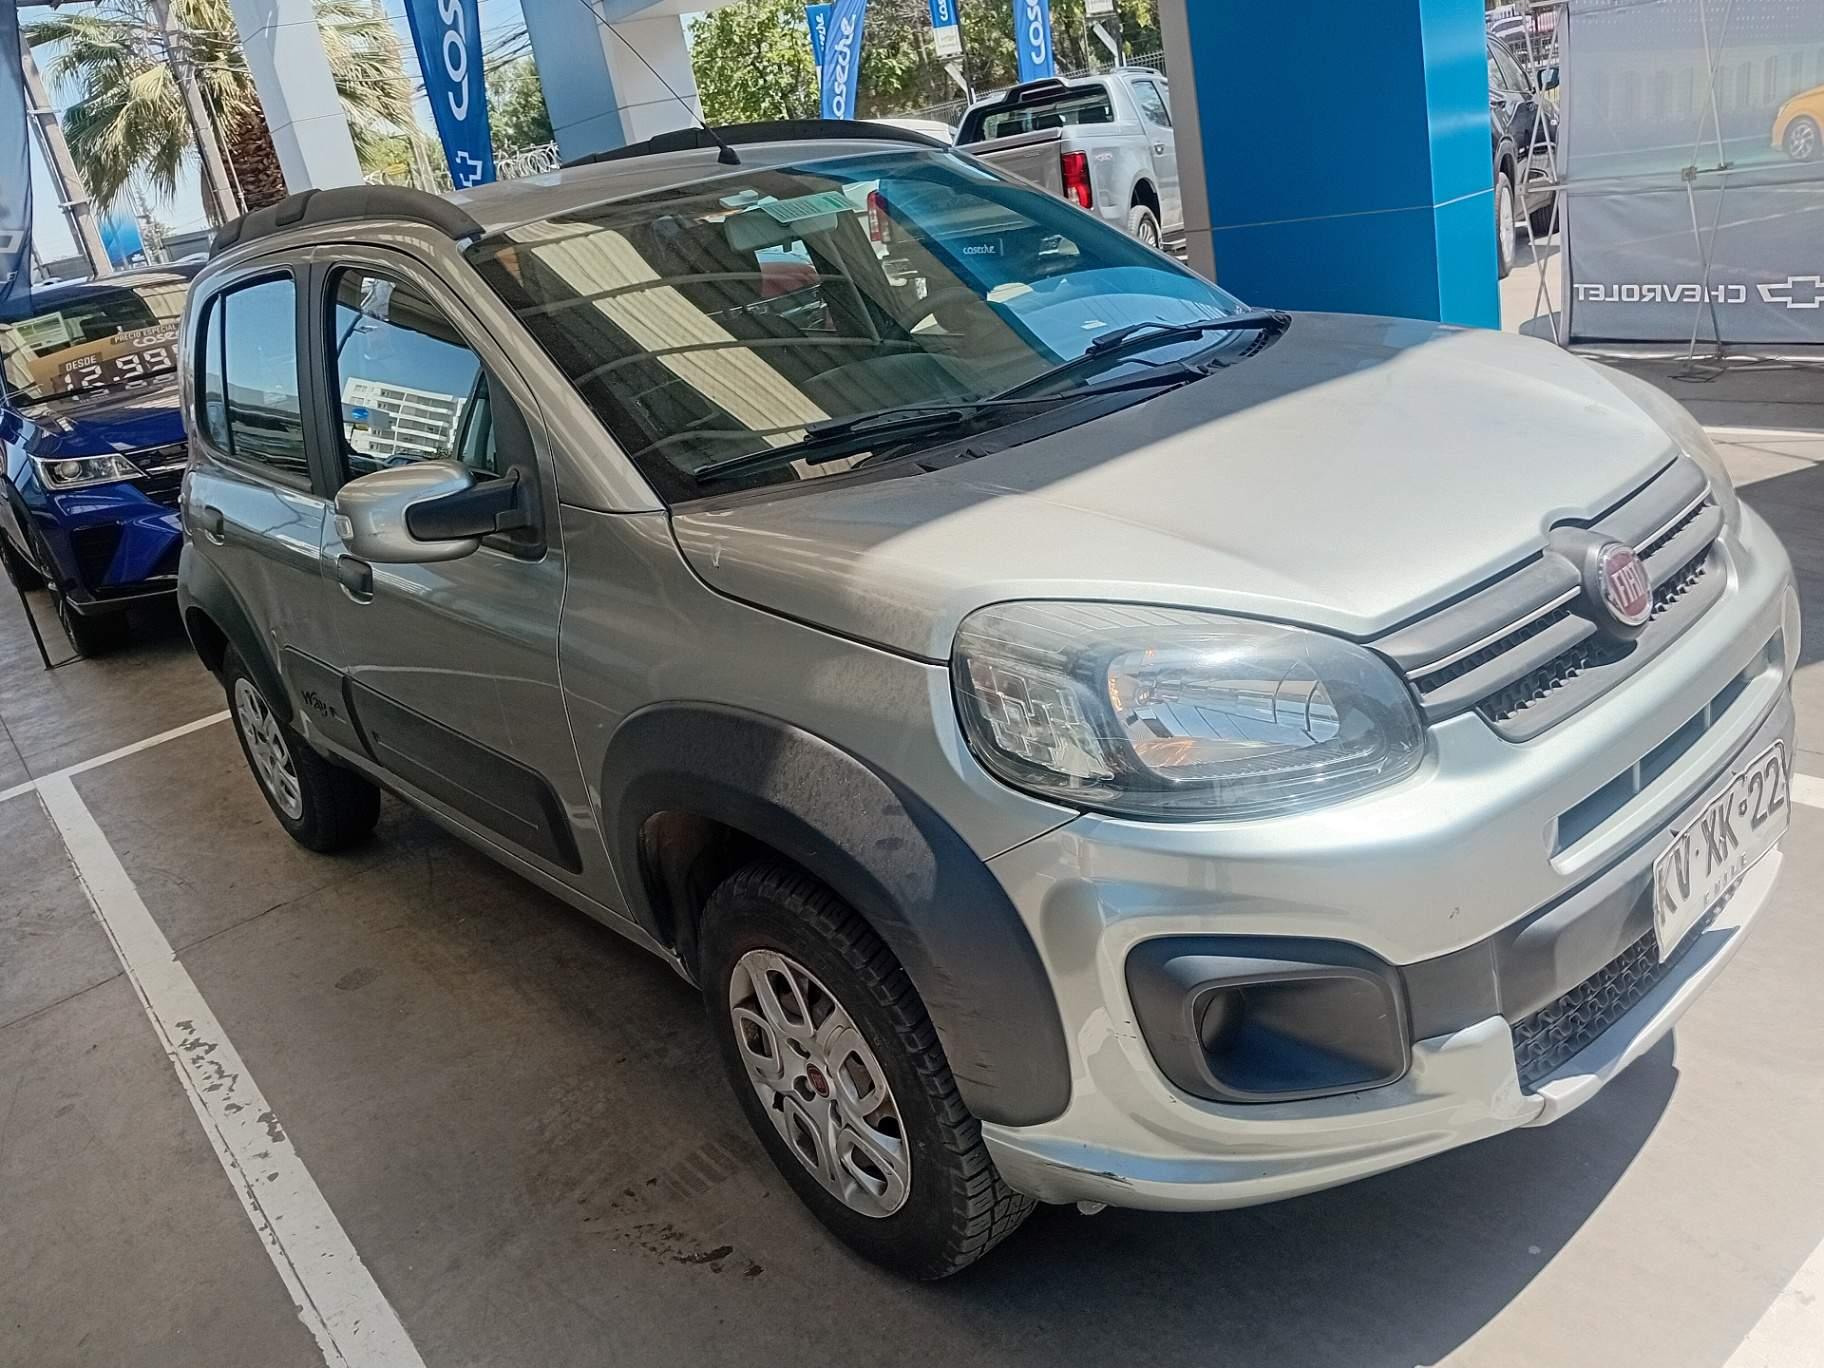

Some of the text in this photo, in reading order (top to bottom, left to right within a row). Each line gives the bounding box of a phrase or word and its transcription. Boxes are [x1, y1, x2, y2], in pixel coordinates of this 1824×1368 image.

[833, 14, 856, 120] oseche
[114, 331, 142, 343] PRECIO
[65, 355, 98, 371] DESDE
